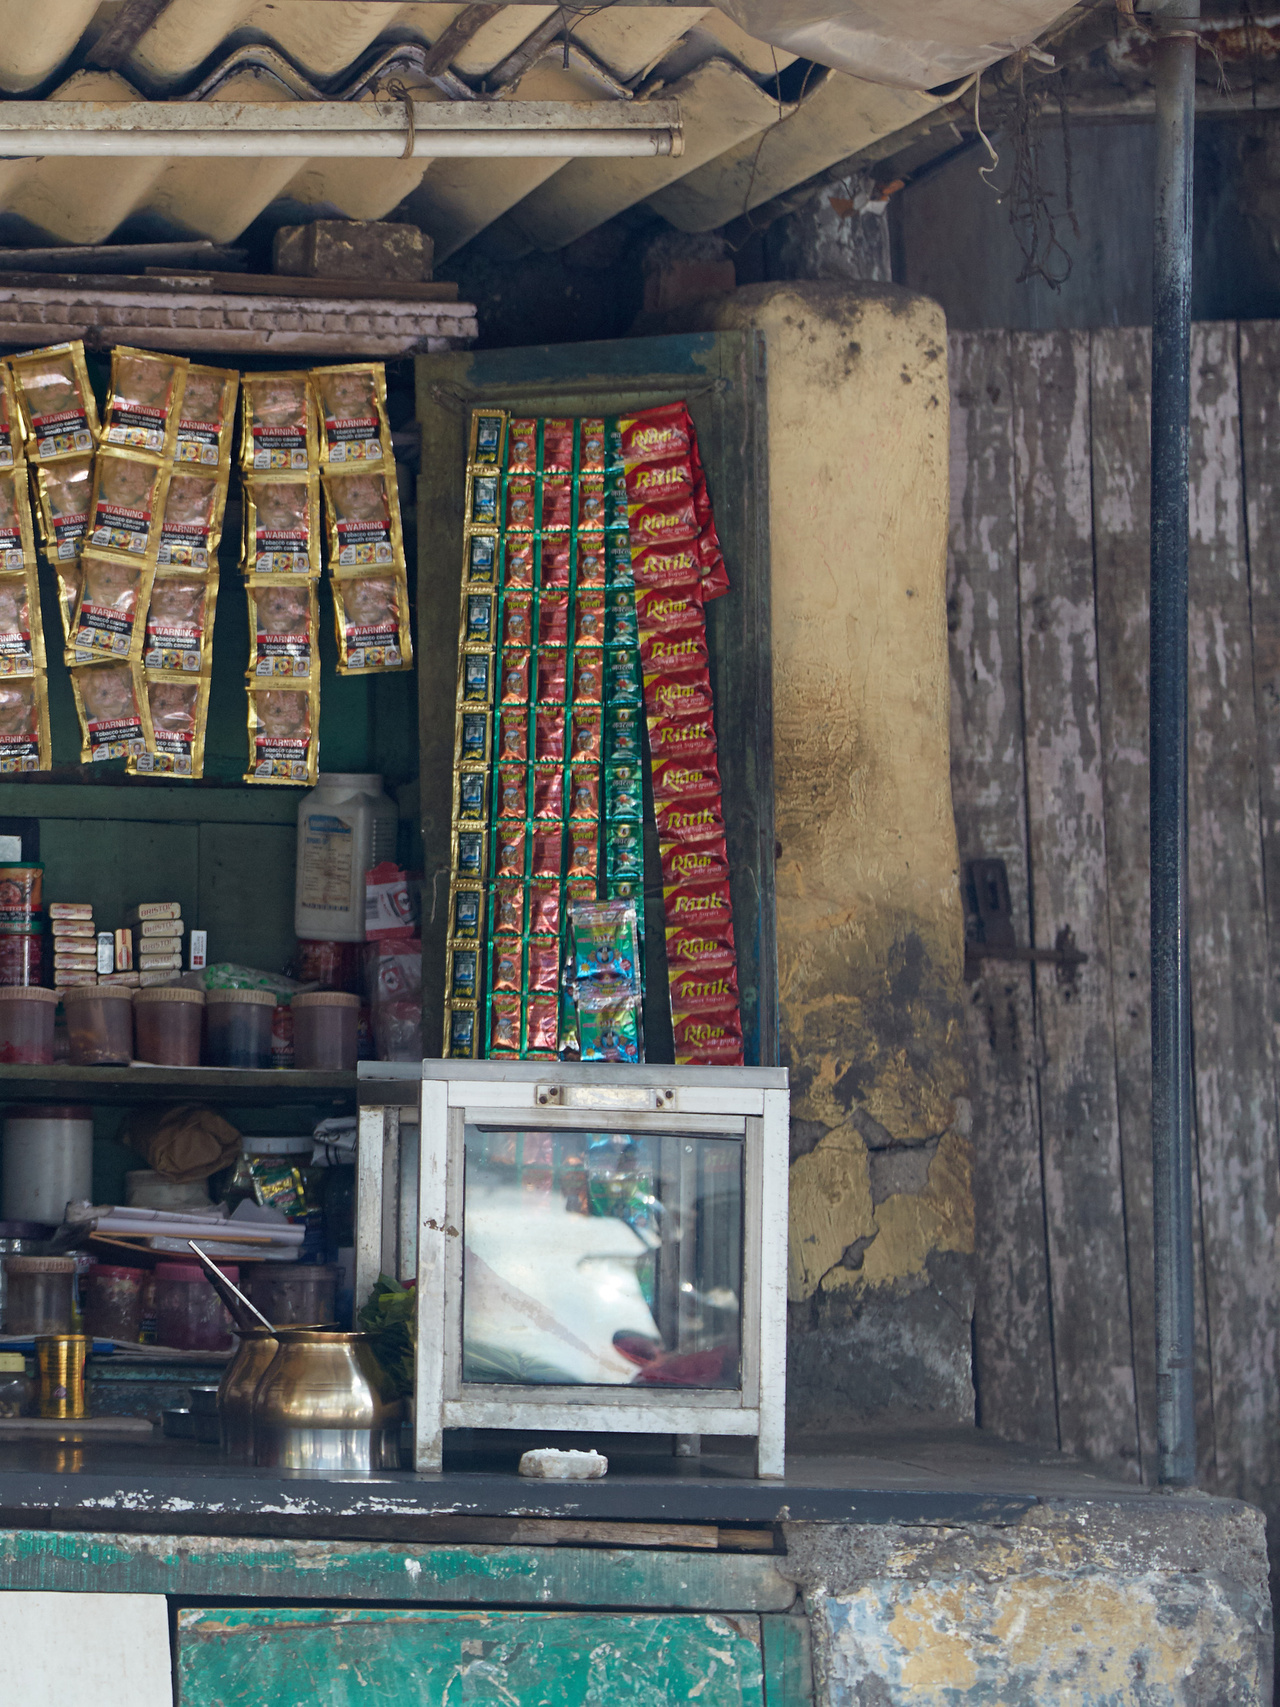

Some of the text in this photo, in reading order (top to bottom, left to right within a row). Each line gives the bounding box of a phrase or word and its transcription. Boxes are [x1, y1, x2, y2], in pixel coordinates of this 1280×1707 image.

[122, 404, 160, 416] WARNING
[42, 412, 79, 423] WARNING
[335, 420, 372, 428] WARNING
[636, 466, 684, 489] Ritik
[106, 506, 143, 518] WARNING
[165, 525, 203, 534] WARNING
[346, 522, 383, 531] WARNING
[643, 552, 693, 574] Ritik
[91, 607, 126, 620] WARNING
[156, 628, 193, 636] WARNING
[355, 626, 392, 635] WARNING
[651, 638, 699, 659] Ritik
[98, 719, 134, 730] WARNING
[661, 723, 707, 744] Ritik
[667, 808, 714, 830] Ritik
[675, 893, 722, 913] Ritik
[141, 904, 172, 917] BRISTOL
[681, 978, 729, 998] Ritik
